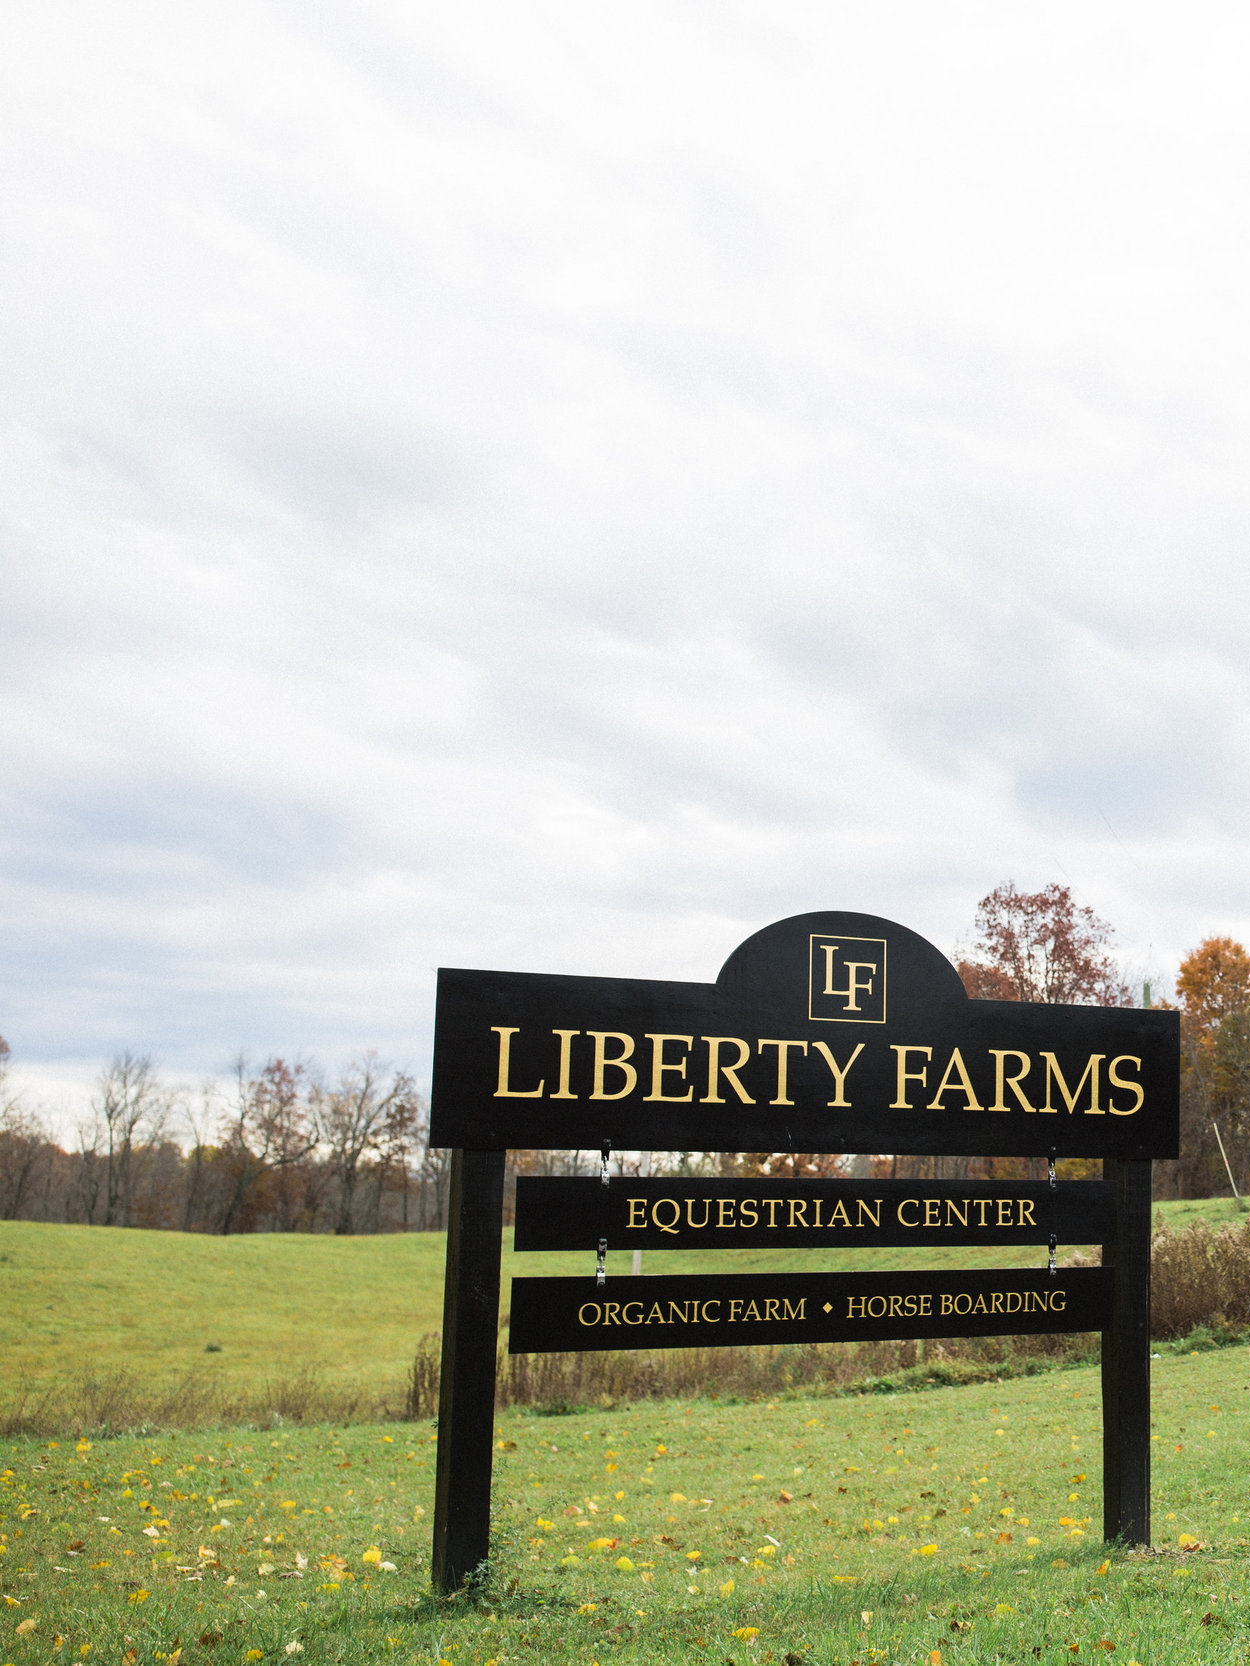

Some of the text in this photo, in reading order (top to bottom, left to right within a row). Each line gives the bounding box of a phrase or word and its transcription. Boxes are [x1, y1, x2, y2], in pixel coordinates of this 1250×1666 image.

[820, 945, 876, 1011] LF
[491, 1026, 1144, 1115] LIBERTY FARMS
[626, 1199, 1036, 1234] EQUESTRIAN CENTER
[579, 1291, 1065, 1326] ORGANIC FARM HORSE BOARDING
